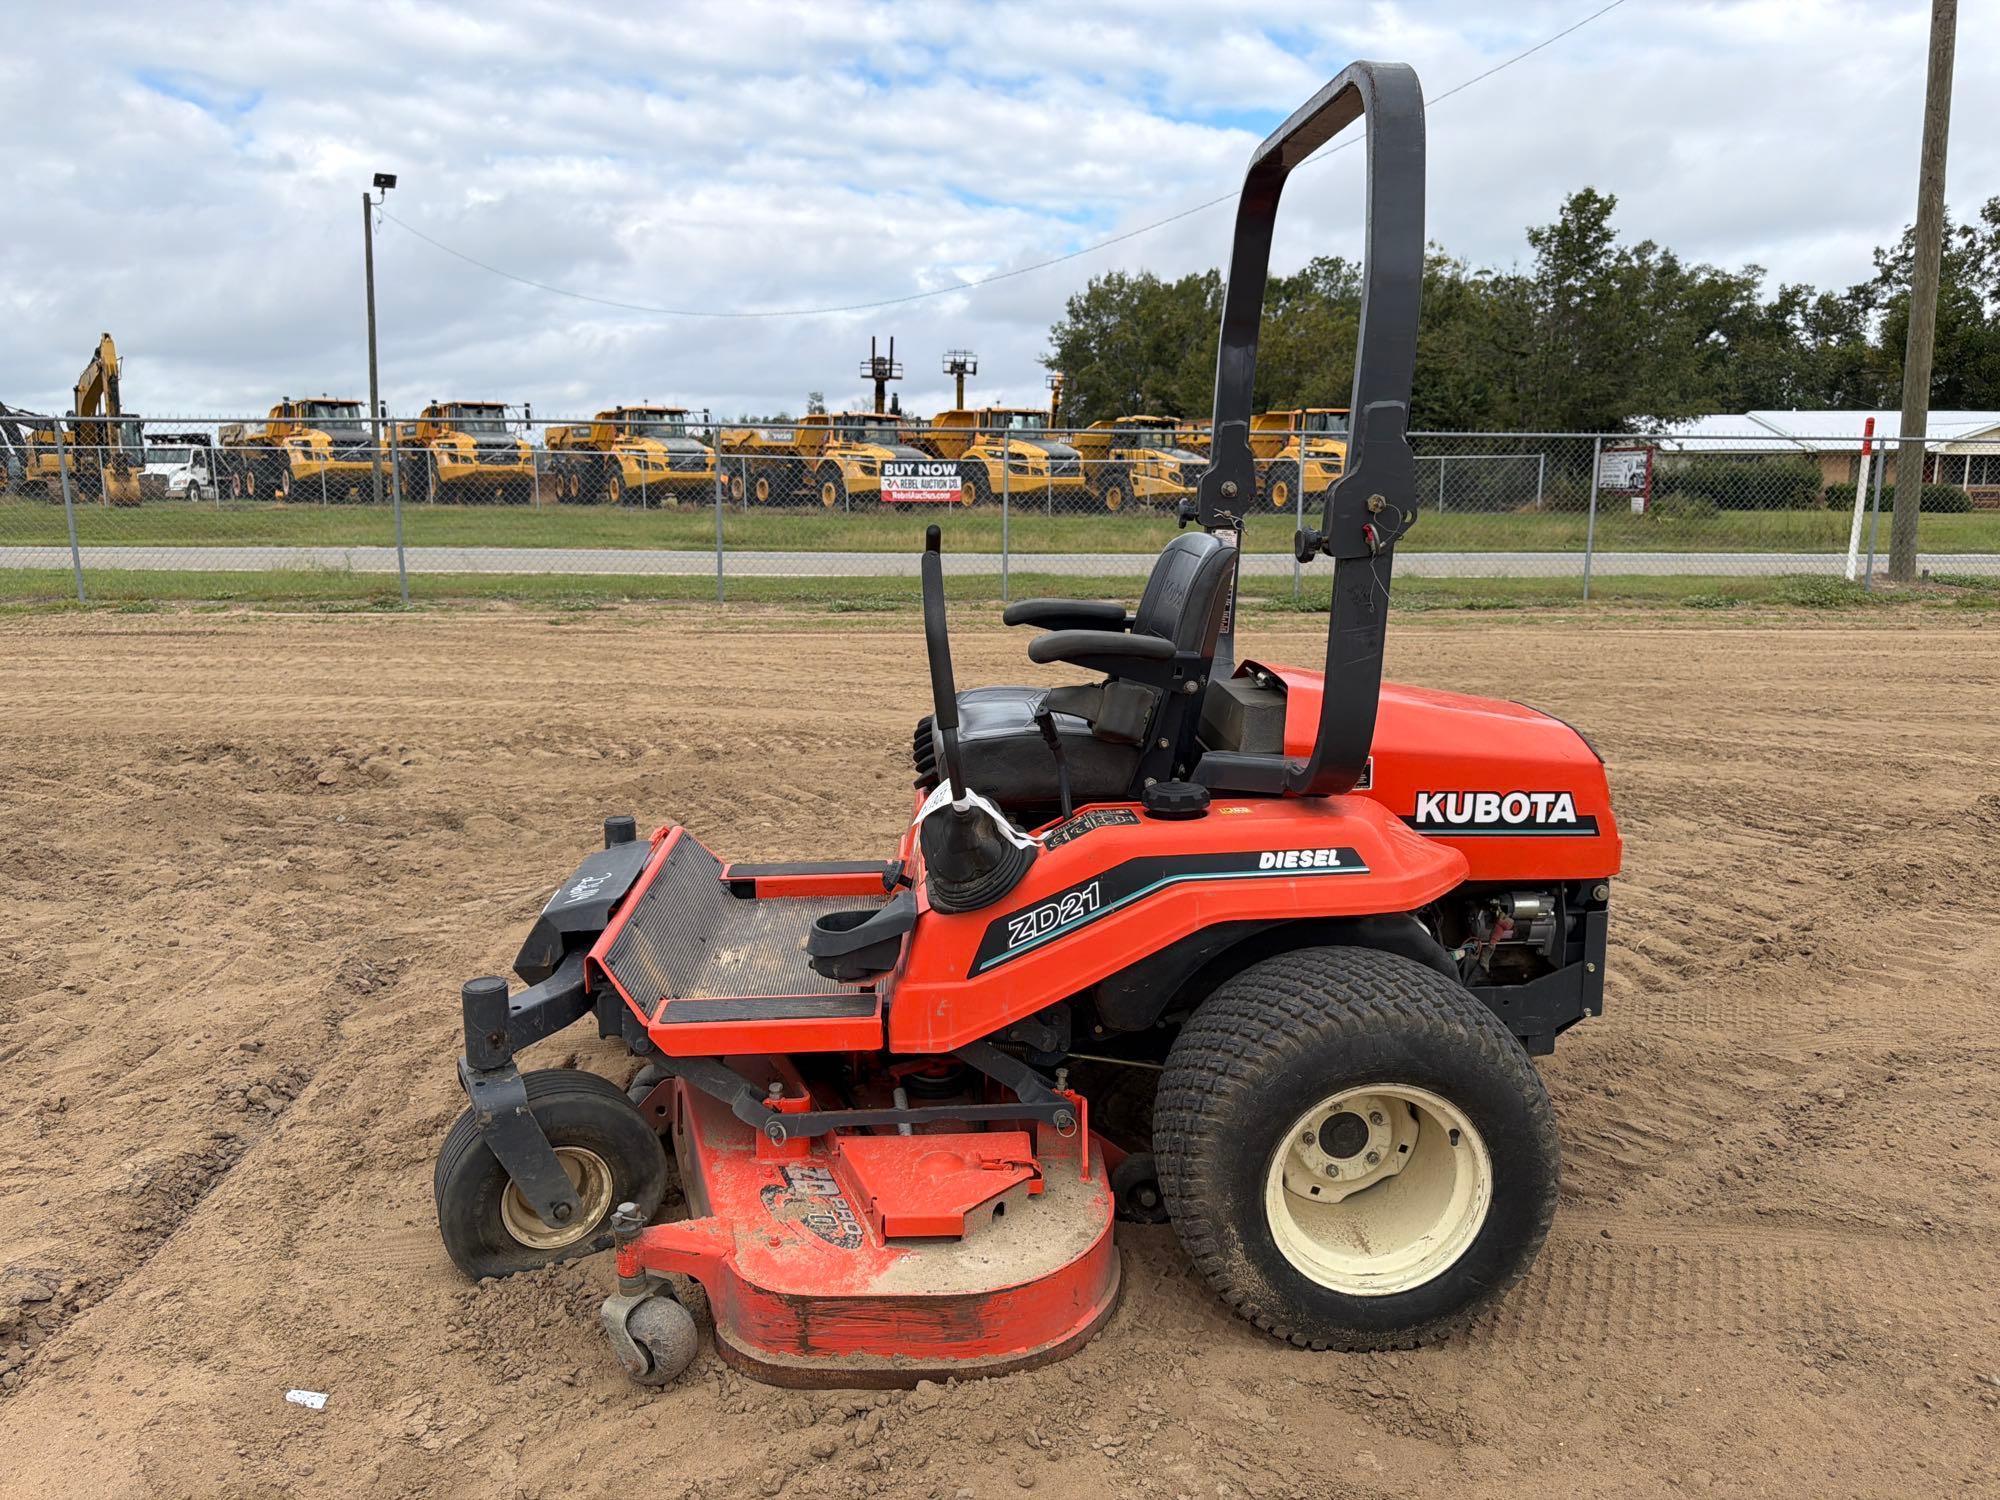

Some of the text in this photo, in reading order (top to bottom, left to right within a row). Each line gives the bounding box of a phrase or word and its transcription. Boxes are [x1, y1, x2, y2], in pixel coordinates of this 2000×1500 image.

[884, 463, 957, 476] BUY NOW
[900, 478, 918, 489] REBEL
[920, 478, 947, 489] AUCTION
[1416, 792, 1577, 824] KUBOTA
[1258, 849, 1341, 870] DIESEL
[1008, 881, 1100, 949] ZD21
[830, 1197, 864, 1235] PRO
